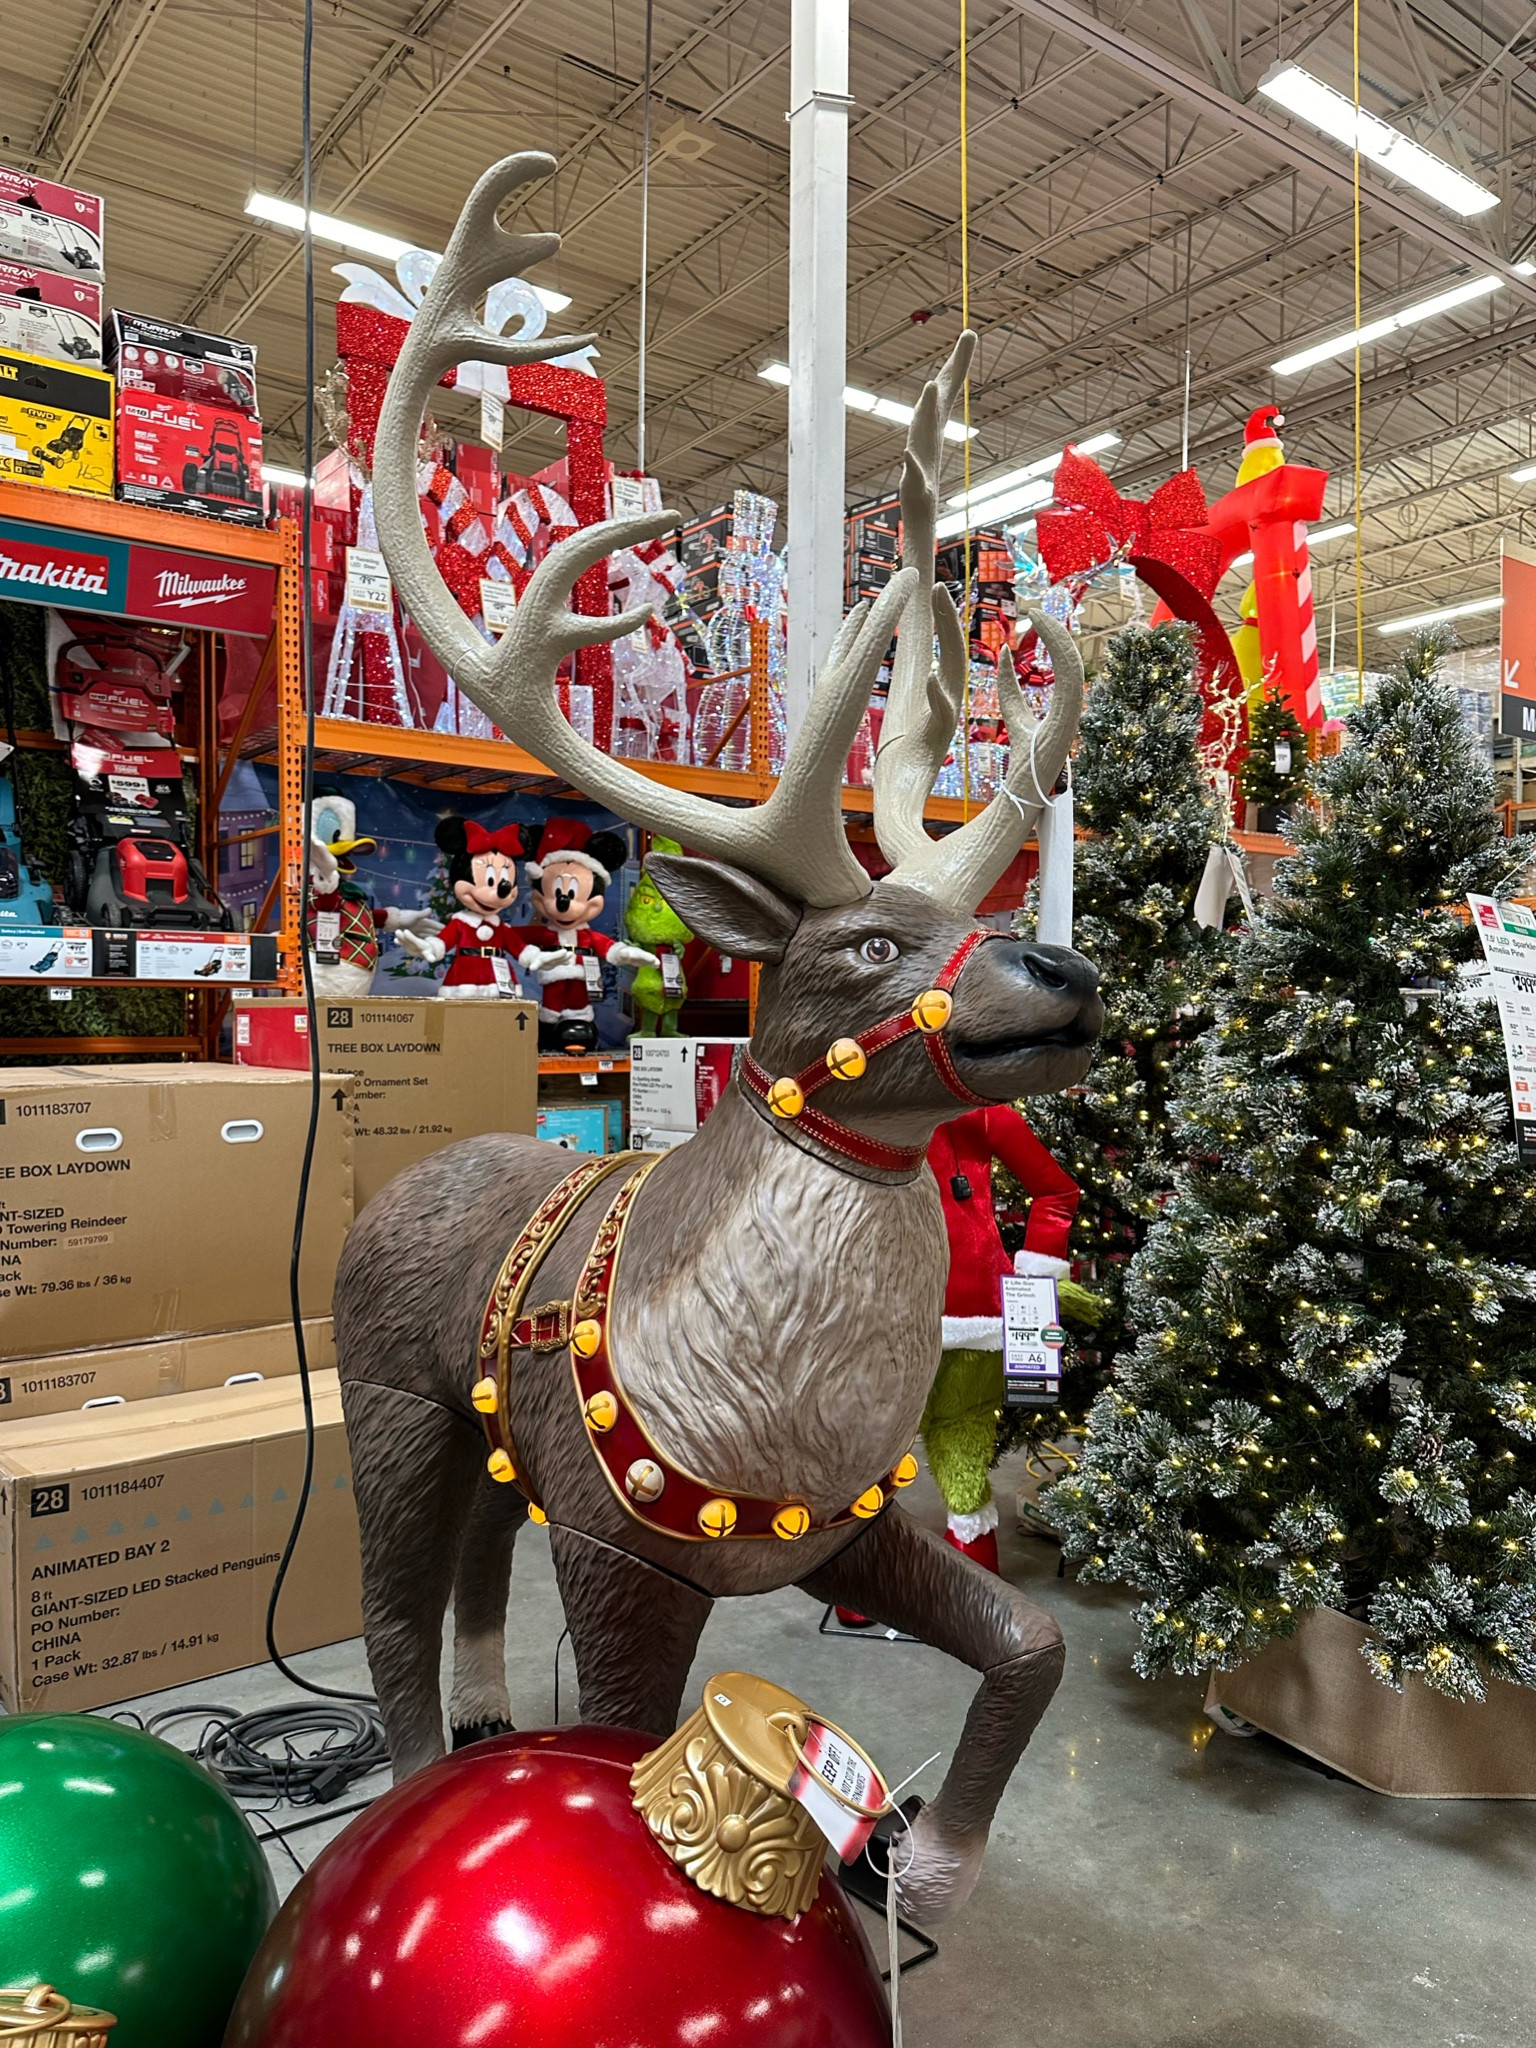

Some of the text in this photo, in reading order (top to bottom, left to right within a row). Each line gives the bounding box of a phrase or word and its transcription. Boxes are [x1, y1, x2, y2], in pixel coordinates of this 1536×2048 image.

[133, 320, 183, 337] MURRAY
[28, 408, 55, 420] RWD
[150, 411, 204, 430] FUEL
[153, 570, 247, 598] Milwaukee
[367, 591, 386, 602] Y22
[108, 695, 149, 707] FUEL
[112, 753, 154, 763] FUEL
[1511, 949, 1525, 958] Pine
[330, 1011, 414, 1025] 28 1011141067
[327, 1043, 440, 1053] TREE BOX LAYDOWN
[364, 1078, 410, 1087] Ornament
[413, 1077, 428, 1086] Set
[16, 1102, 91, 1117] 1011183707
[354, 1128, 371, 1136] Wt:
[373, 1127, 398, 1135] 48.32
[419, 1125, 442, 1134] 21.92
[20, 1164, 52, 1178] BOX
[57, 1159, 130, 1175] LAYDOWN
[0, 1207, 64, 1221] NT-SIZED
[7, 1216, 127, 1235] Towering Reindeer
[0, 1238, 57, 1250] Number:
[1, 1255, 22, 1266] NA
[15, 1285, 37, 1296] Wt:
[41, 1280, 74, 1293] 79.36
[77, 1281, 91, 1289] lbs
[94, 1276, 100, 1286] /
[103, 1275, 118, 1285] 36
[120, 1276, 131, 1284] kg
[1028, 1354, 1042, 1363] A6
[21, 1371, 96, 1394] 1011183707
[35, 1474, 164, 1513] 28 1011184407
[31, 1539, 170, 1581] ANIMATED BAY 2
[31, 1552, 281, 1617] GIANT-SIZED LED Stacked Penguins
[31, 1591, 53, 1603] 8 ft
[31, 1607, 120, 1636] PO Number:
[31, 1632, 82, 1653] CHINA
[31, 1650, 82, 1671] 1 Pack
[32, 1633, 219, 1688] Case Wt: 32.87 lbs / 14.91 kg
[822, 1759, 838, 1785] EEP
